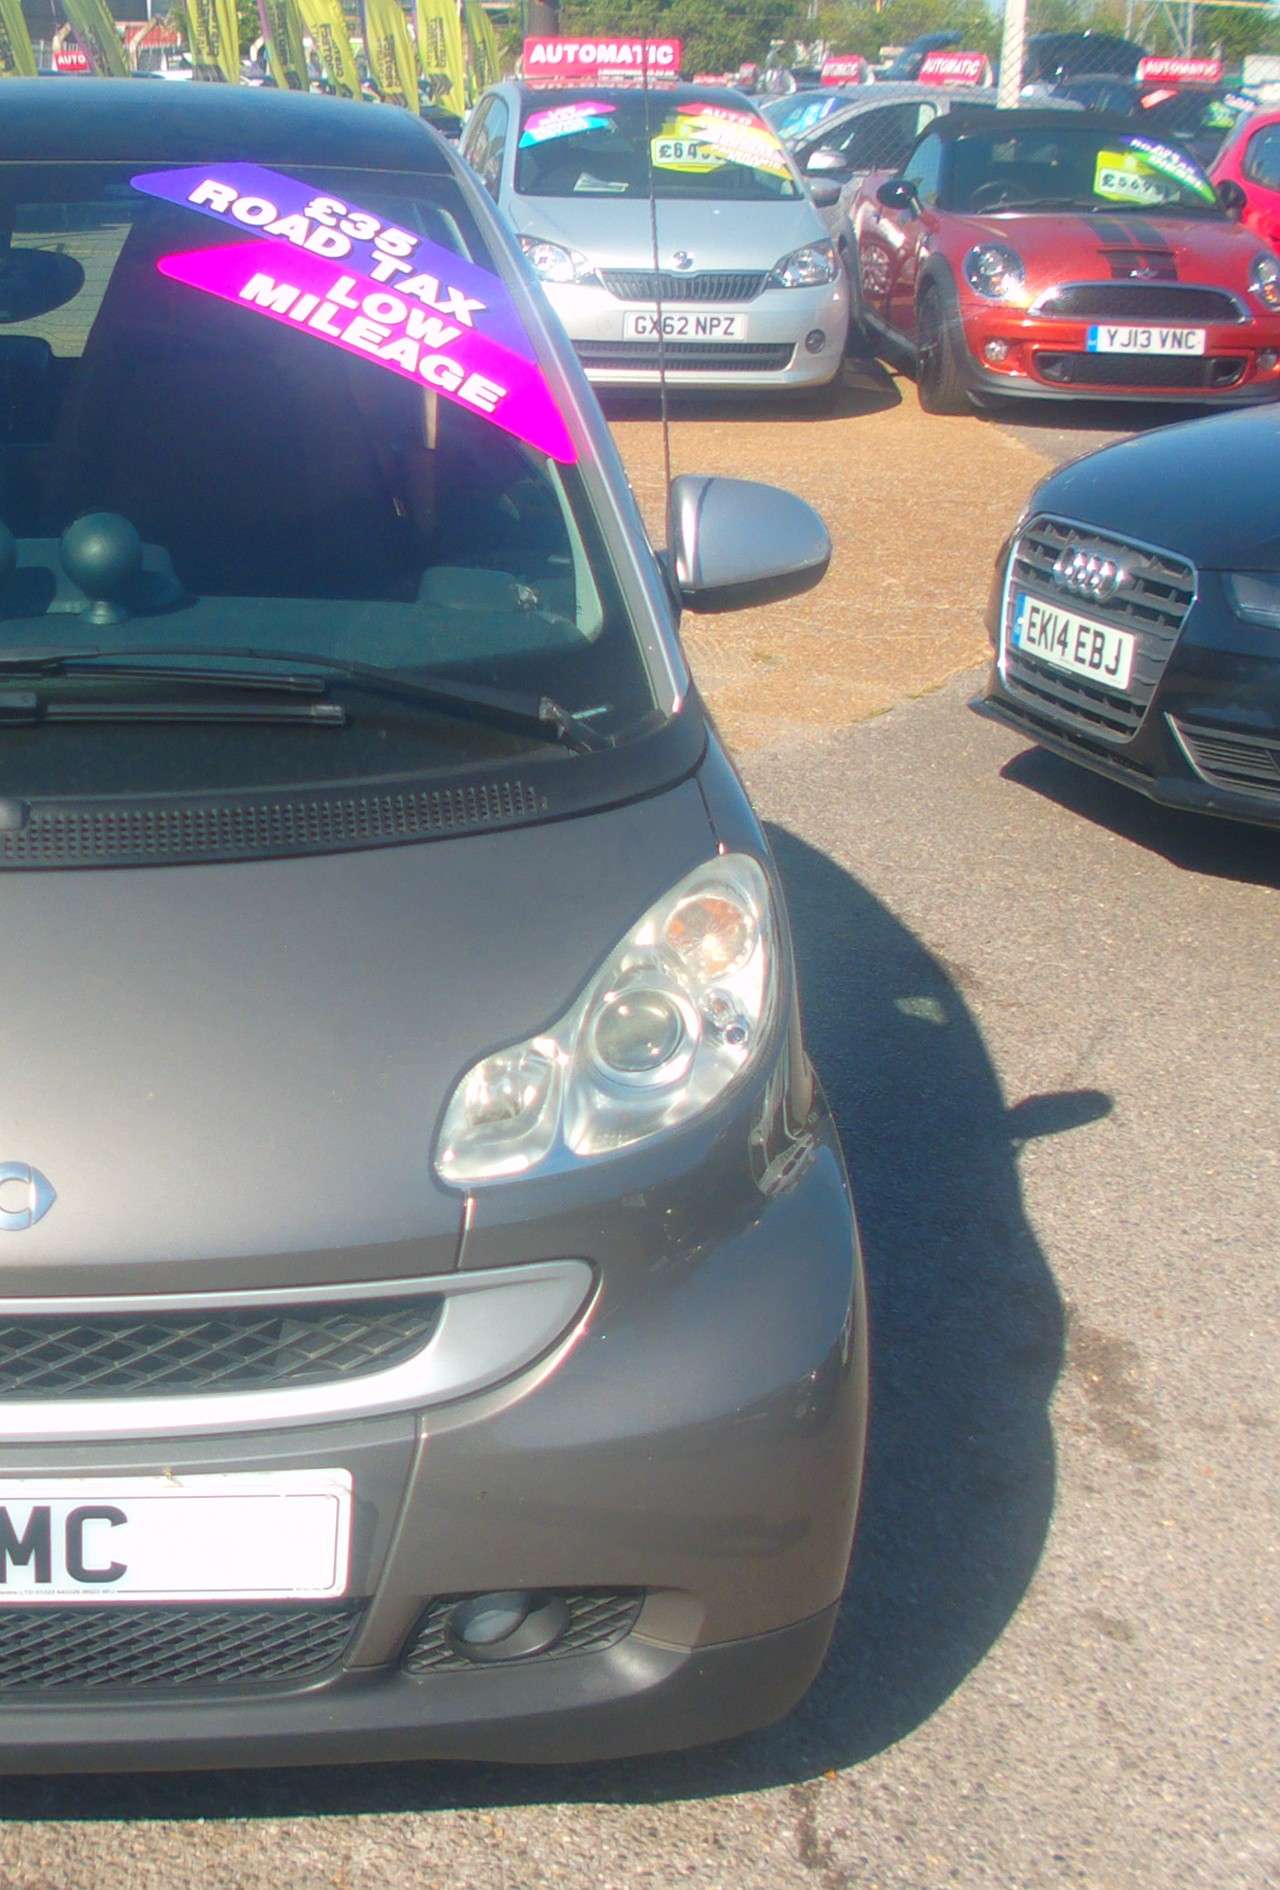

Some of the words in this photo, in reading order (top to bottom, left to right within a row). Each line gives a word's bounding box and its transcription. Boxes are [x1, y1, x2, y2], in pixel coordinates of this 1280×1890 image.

[58, 54, 86, 64] AUTO
[529, 43, 674, 65] AUTOMATIC
[921, 57, 980, 76] AUTOMATIC
[303, 196, 418, 259] £35
[188, 178, 352, 259] ROAD
[369, 252, 487, 327] TAX
[325, 276, 462, 348] LOW
[634, 316, 689, 335] GX62
[694, 316, 736, 336] NPZ
[239, 272, 507, 413] MILEAGE
[1106, 328, 1153, 348] YJ13
[1159, 330, 1197, 350] VNC
[1025, 605, 1071, 657] EK14
[1073, 623, 1124, 677] EBJ
